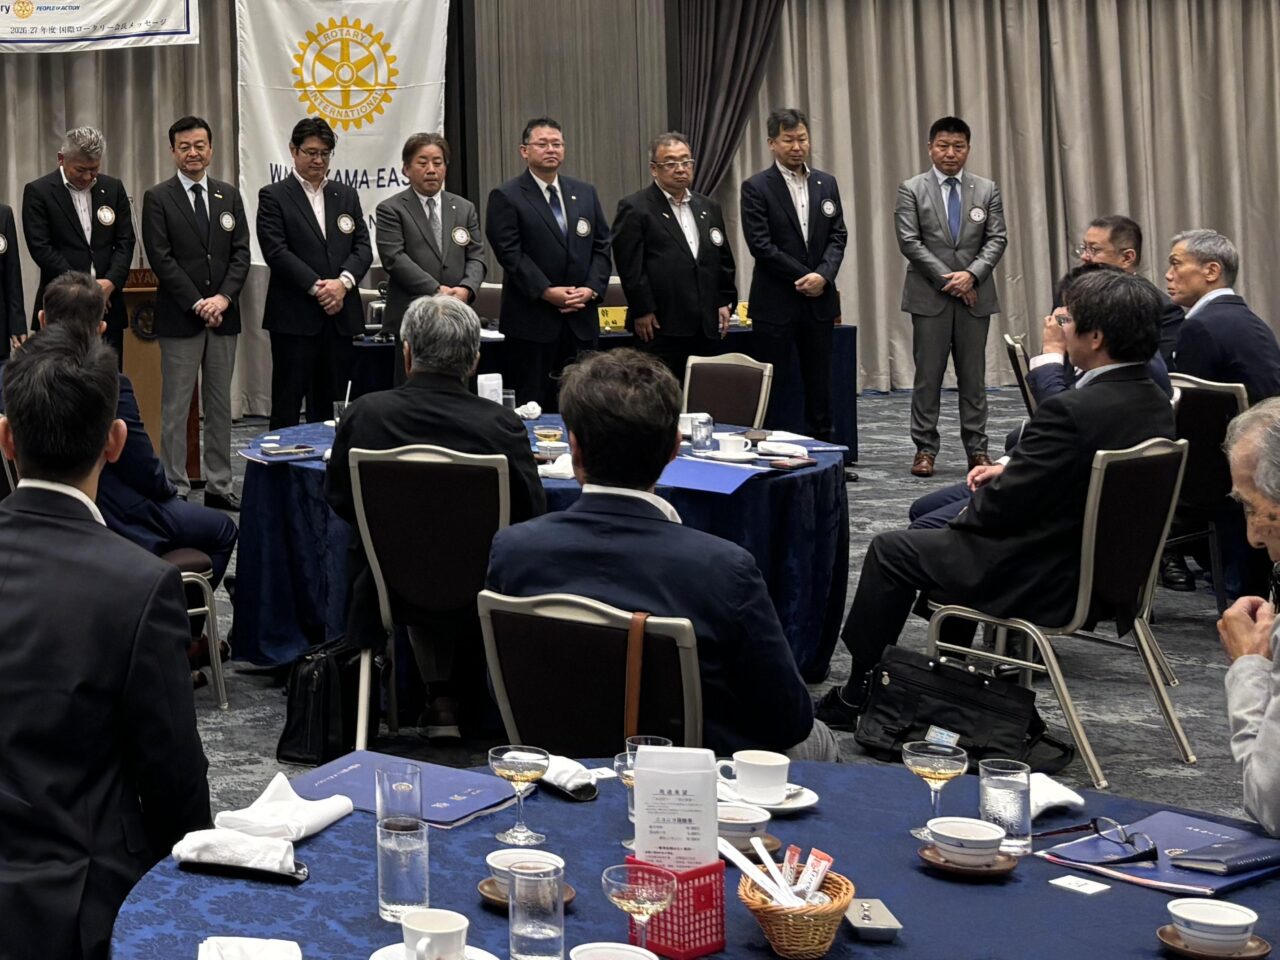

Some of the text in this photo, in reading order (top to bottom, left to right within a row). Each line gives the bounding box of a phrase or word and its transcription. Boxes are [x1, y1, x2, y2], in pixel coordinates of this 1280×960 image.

[323, 28, 367, 42] ROTARY
[308, 88, 383, 118] INTERNATIONAL
[270, 163, 370, 189] WAAMA
